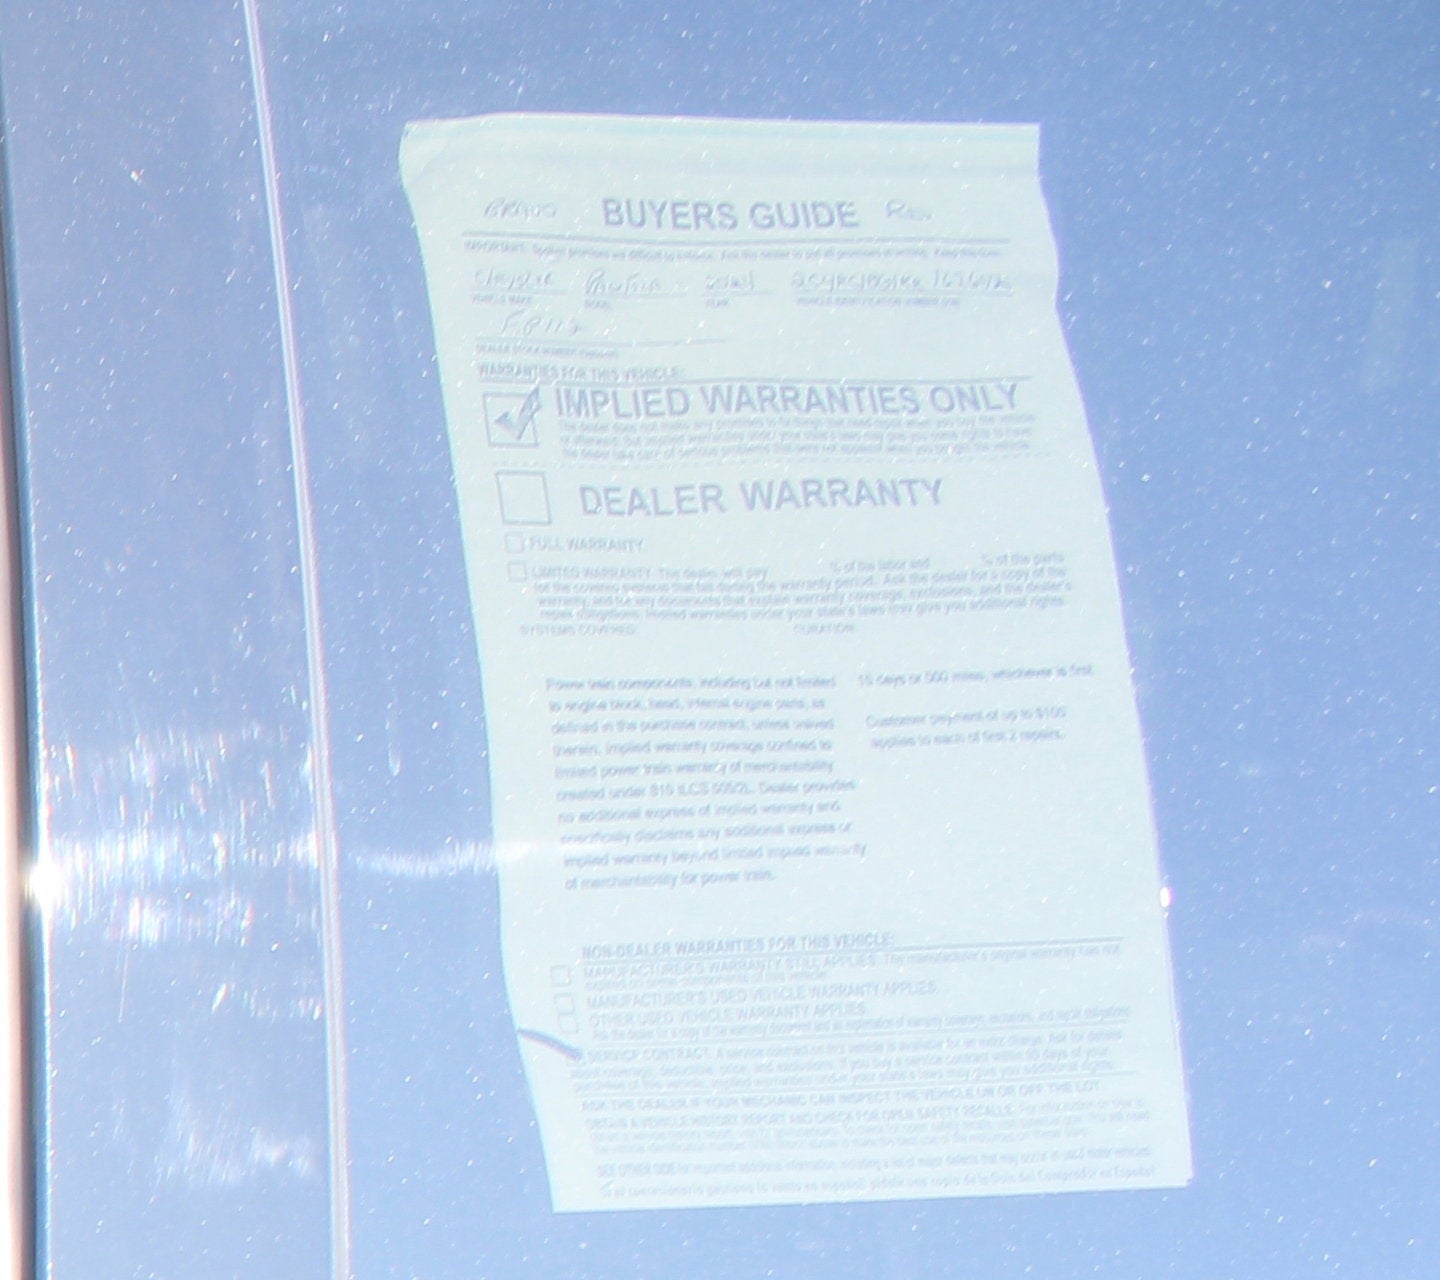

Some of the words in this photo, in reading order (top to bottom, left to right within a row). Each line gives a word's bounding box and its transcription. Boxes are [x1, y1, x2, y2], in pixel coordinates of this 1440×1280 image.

[602, 196, 739, 231] BUYERS
[749, 199, 861, 230] GUIDE
[555, 385, 691, 419] IMPLIED
[700, 384, 921, 415] WARRANTIES
[929, 383, 1018, 412] ONLY
[579, 482, 728, 517] DEALER
[739, 477, 943, 511] WARRANTY
